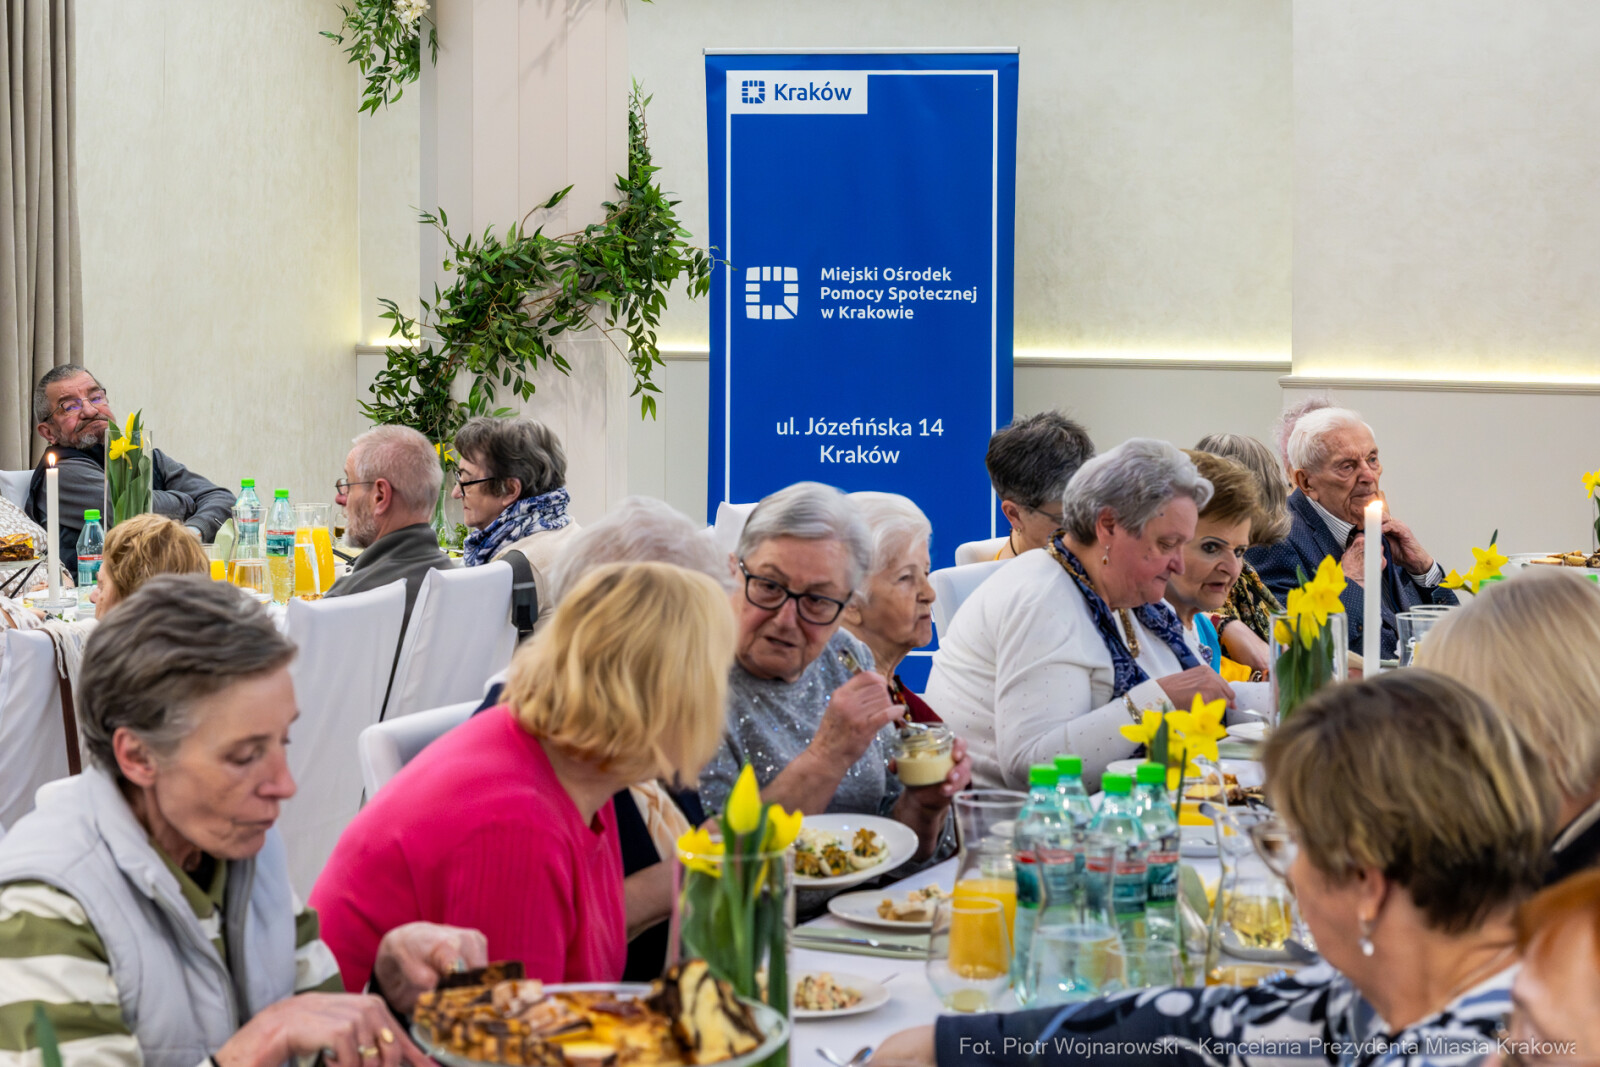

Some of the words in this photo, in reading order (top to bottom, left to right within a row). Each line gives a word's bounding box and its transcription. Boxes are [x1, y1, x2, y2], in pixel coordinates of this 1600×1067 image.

[774, 81, 852, 102] Kraków
[820, 266, 878, 284] Miejski
[883, 266, 952, 282] Ośrodek
[820, 286, 884, 303] Pomocy
[889, 286, 977, 303] Społecznej
[821, 308, 835, 319] w
[839, 305, 914, 320] Krakowie
[776, 416, 800, 435] ul.
[804, 416, 912, 436] Józefińska
[918, 418, 944, 437] 14
[820, 444, 900, 464] Kraków
